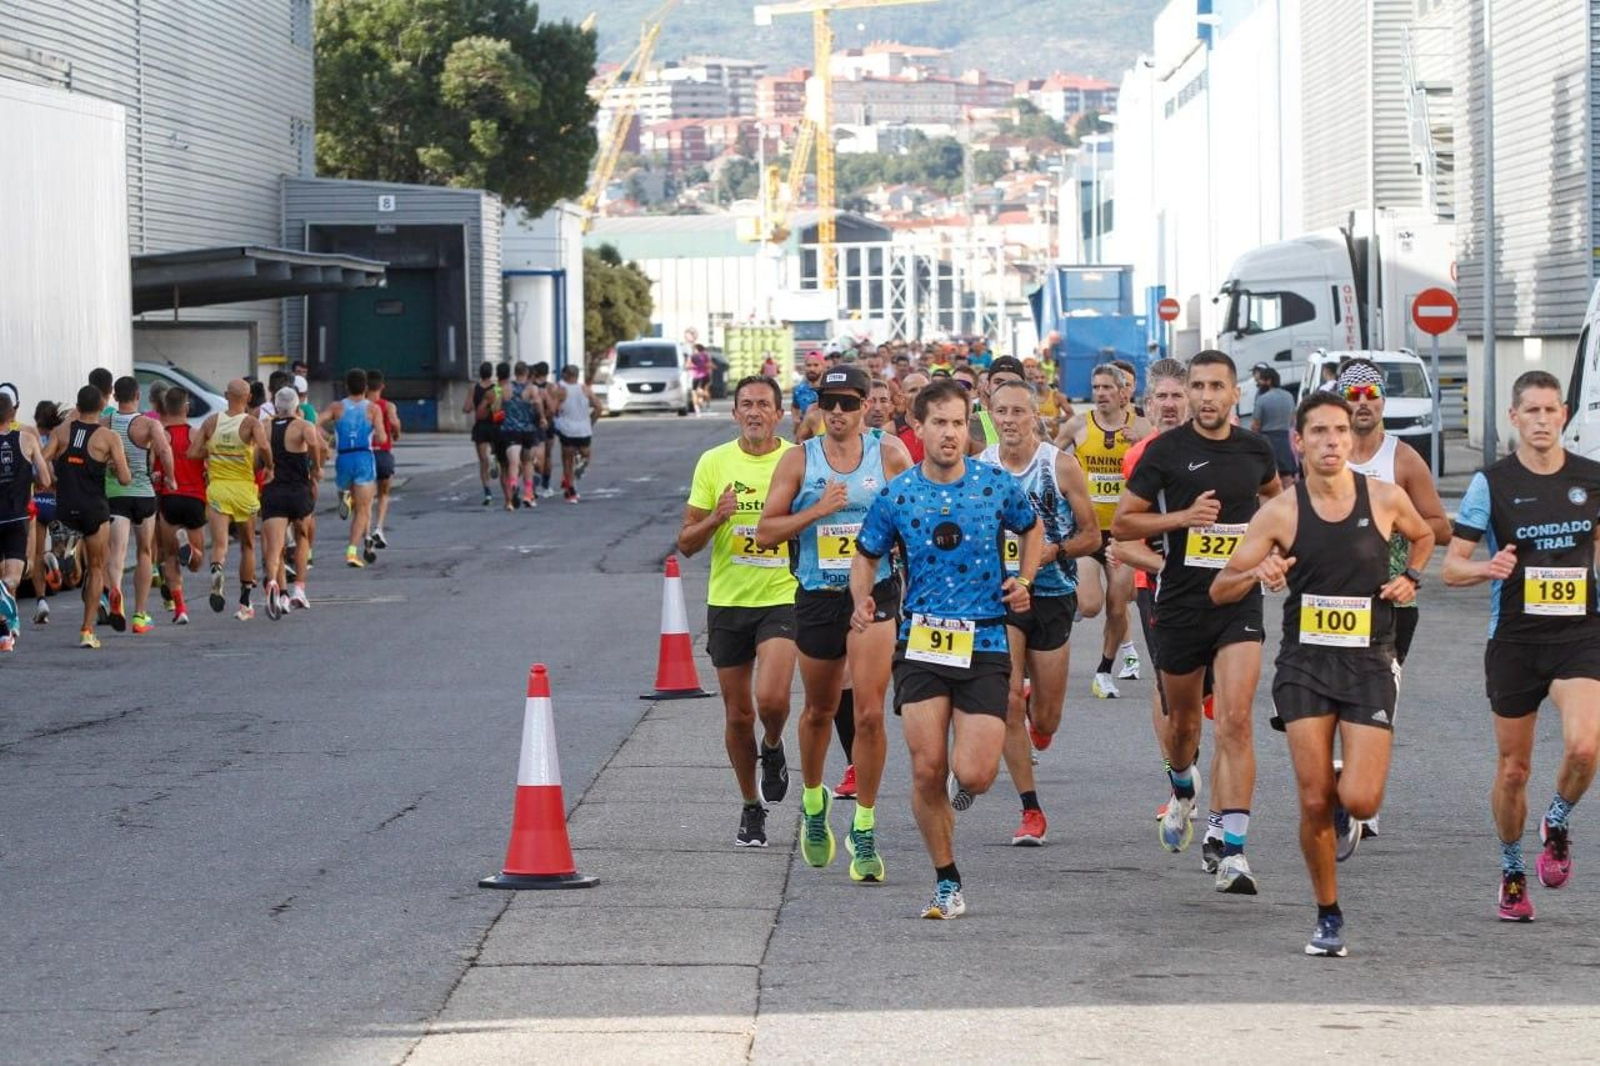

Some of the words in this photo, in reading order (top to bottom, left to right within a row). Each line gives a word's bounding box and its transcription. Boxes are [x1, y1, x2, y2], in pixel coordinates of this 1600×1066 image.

[383, 198, 391, 210] 8
[1096, 482, 1121, 494] 104
[1516, 520, 1592, 539] CONDADO
[1199, 535, 1238, 555] 327
[1534, 535, 1576, 550] TRAIL
[1539, 581, 1576, 601] 189
[1315, 610, 1357, 632] 100
[931, 630, 954, 651] 91
